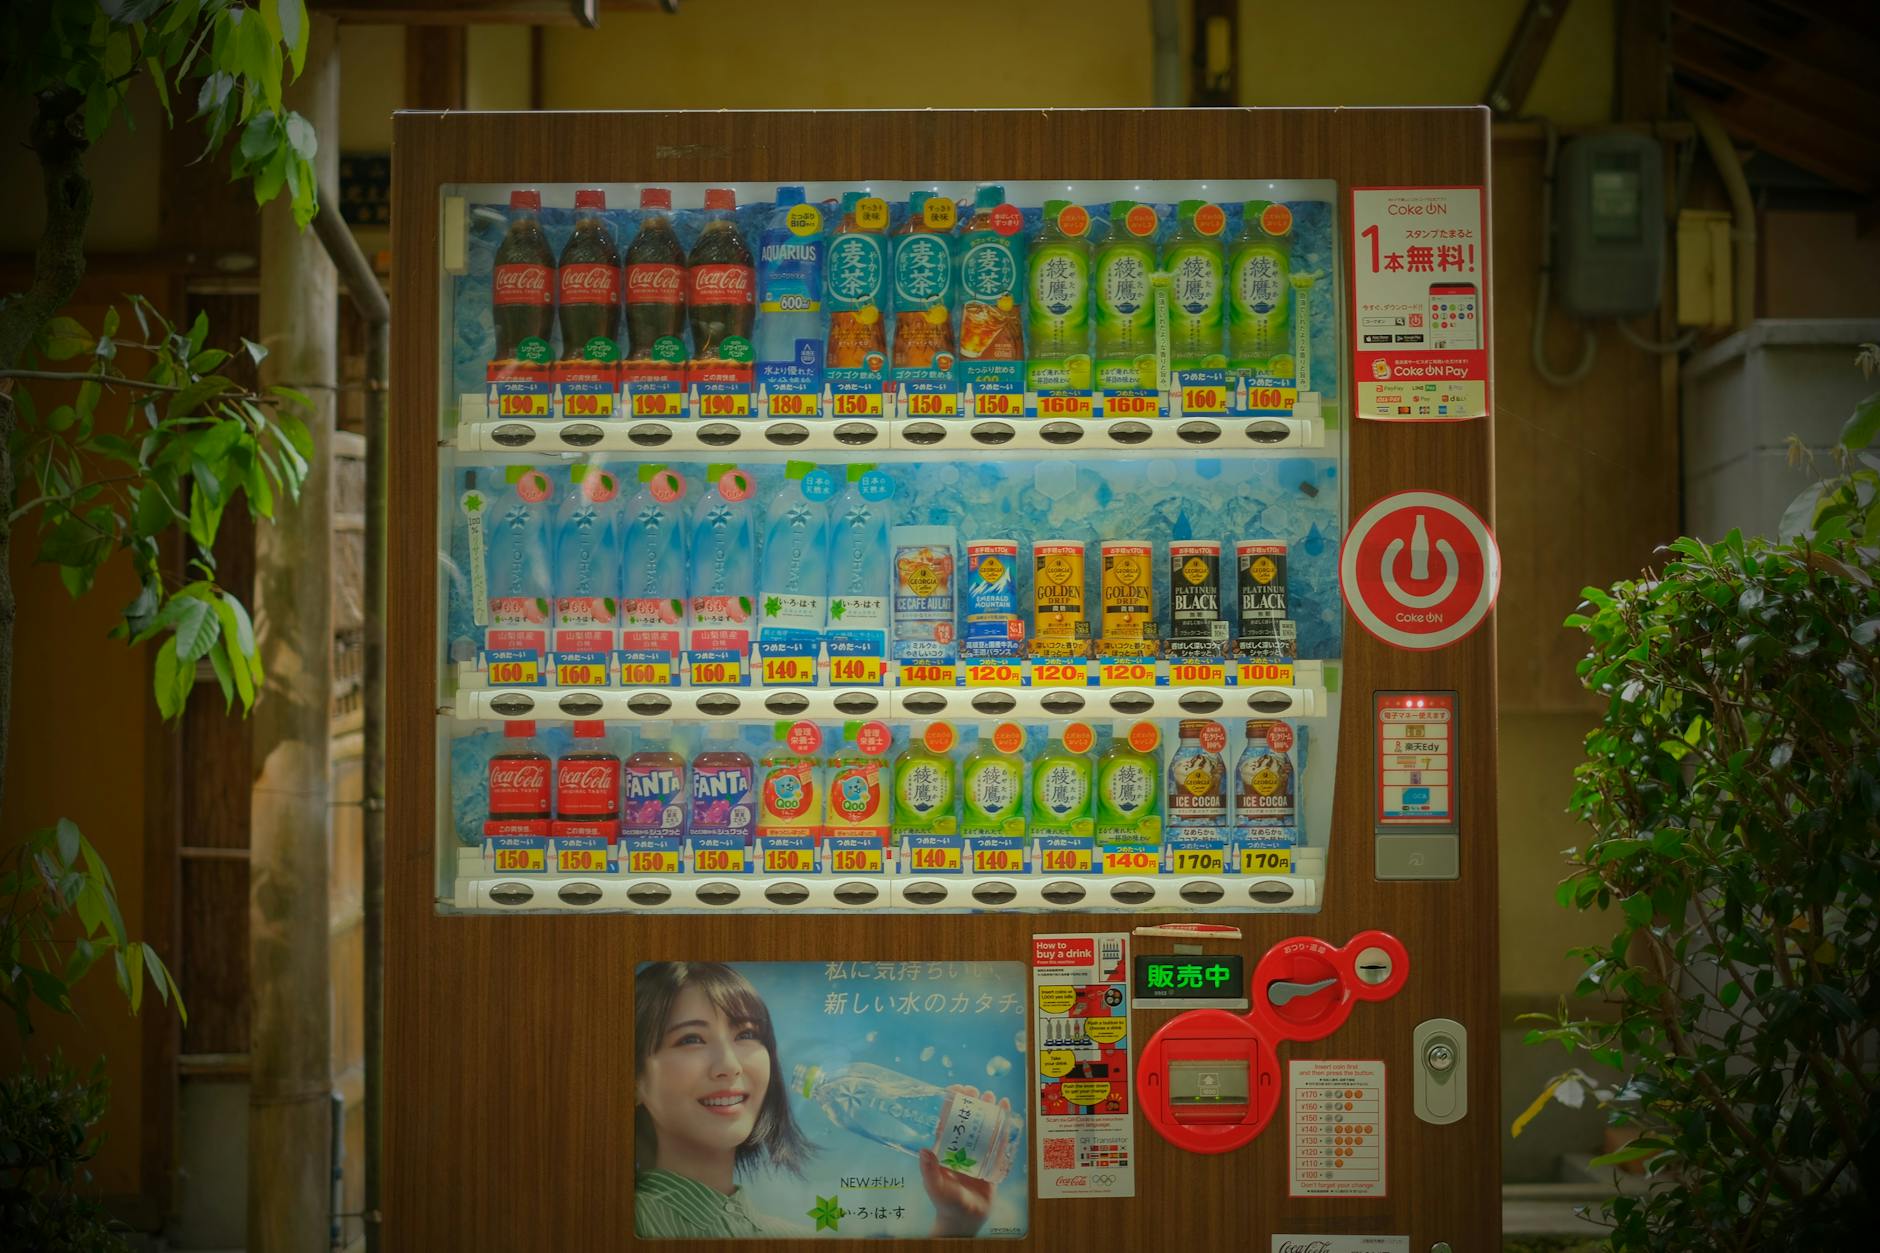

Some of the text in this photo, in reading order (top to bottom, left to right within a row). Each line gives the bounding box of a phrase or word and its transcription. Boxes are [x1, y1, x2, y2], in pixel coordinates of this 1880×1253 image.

[1388, 204, 1423, 215] Coke
[1406, 230, 1473, 239] スタンプたまると
[761, 245, 816, 261] AQUARIUS
[1361, 224, 1474, 273] 1本無料!
[839, 240, 868, 295] 麦茶
[907, 241, 937, 295] 麦茶
[976, 250, 1002, 294] 麦茶
[1047, 257, 1068, 302] 綾鷹
[1115, 257, 1137, 302] 綾鷹
[1184, 256, 1204, 301] 綾鷹
[1250, 256, 1272, 301] 綾鷹
[764, 366, 814, 376] 水より優れた
[828, 371, 881, 380] ゴクゴク飲める
[1394, 367, 1424, 376] Coke
[1446, 367, 1468, 378] Pay
[503, 396, 544, 414] 190円
[567, 396, 609, 414] 190円
[636, 395, 677, 414] 190円
[703, 395, 745, 414] 190円
[771, 395, 813, 414] 180円
[836, 395, 878, 414] 150円
[912, 395, 953, 414] 150円
[978, 395, 1020, 414] 150円
[1041, 397, 1089, 413] 160円
[1106, 397, 1156, 412] 160円
[1037, 585, 1080, 600] GOLDEN
[1106, 585, 1149, 600] GOLDEN
[1176, 586, 1216, 594] PLATINUM
[1243, 586, 1285, 594] PLATINUM
[1176, 595, 1218, 610] BLACK
[1243, 594, 1285, 609] BLACK
[1395, 613, 1424, 622] Coke
[492, 663, 534, 682] 160円
[560, 666, 602, 684] 160円
[625, 665, 666, 683] 160円
[695, 664, 736, 682] 160円
[767, 660, 808, 679] 140円
[834, 660, 875, 679] 140円
[904, 667, 952, 681] 140円
[969, 666, 1018, 681] 120円
[1034, 666, 1084, 680] 120円
[1103, 665, 1153, 680] 120円
[1173, 666, 1221, 680] 100円
[1240, 665, 1289, 680] 100円
[1405, 742, 1439, 752] 楽天Edy
[627, 771, 680, 798] FANTA
[694, 771, 747, 798] FANTA
[913, 766, 932, 802] 綾鷹
[982, 767, 1001, 803] 綾鷹
[1051, 767, 1070, 803] 綾鷹
[1118, 765, 1137, 801] 綾鷹
[776, 799, 798, 808] Qoo
[843, 800, 865, 810] Qoo
[1176, 796, 1220, 807] ICE COCOA
[1243, 796, 1288, 807] ICE COCOA
[500, 850, 540, 870] 150円
[562, 851, 602, 870] 150円
[633, 852, 674, 871] 150円
[698, 851, 740, 870] 150円
[768, 852, 809, 870] 150円
[836, 852, 877, 870] 150円
[915, 849, 956, 868] 140円
[977, 851, 1018, 870] 140円
[1046, 850, 1088, 870] 140円
[1106, 854, 1156, 868] 140円
[1179, 855, 1220, 869] 170円
[1246, 854, 1288, 868] 170円
[1037, 950, 1056, 959] buy
[1066, 949, 1092, 958] drink
[1147, 964, 1230, 988] 販売中
[824, 992, 1024, 1015] 新しい水のカタチ。
[841, 1177, 904, 1188] NEWボトル!
[840, 1206, 905, 1219] い・ろ・は・す
